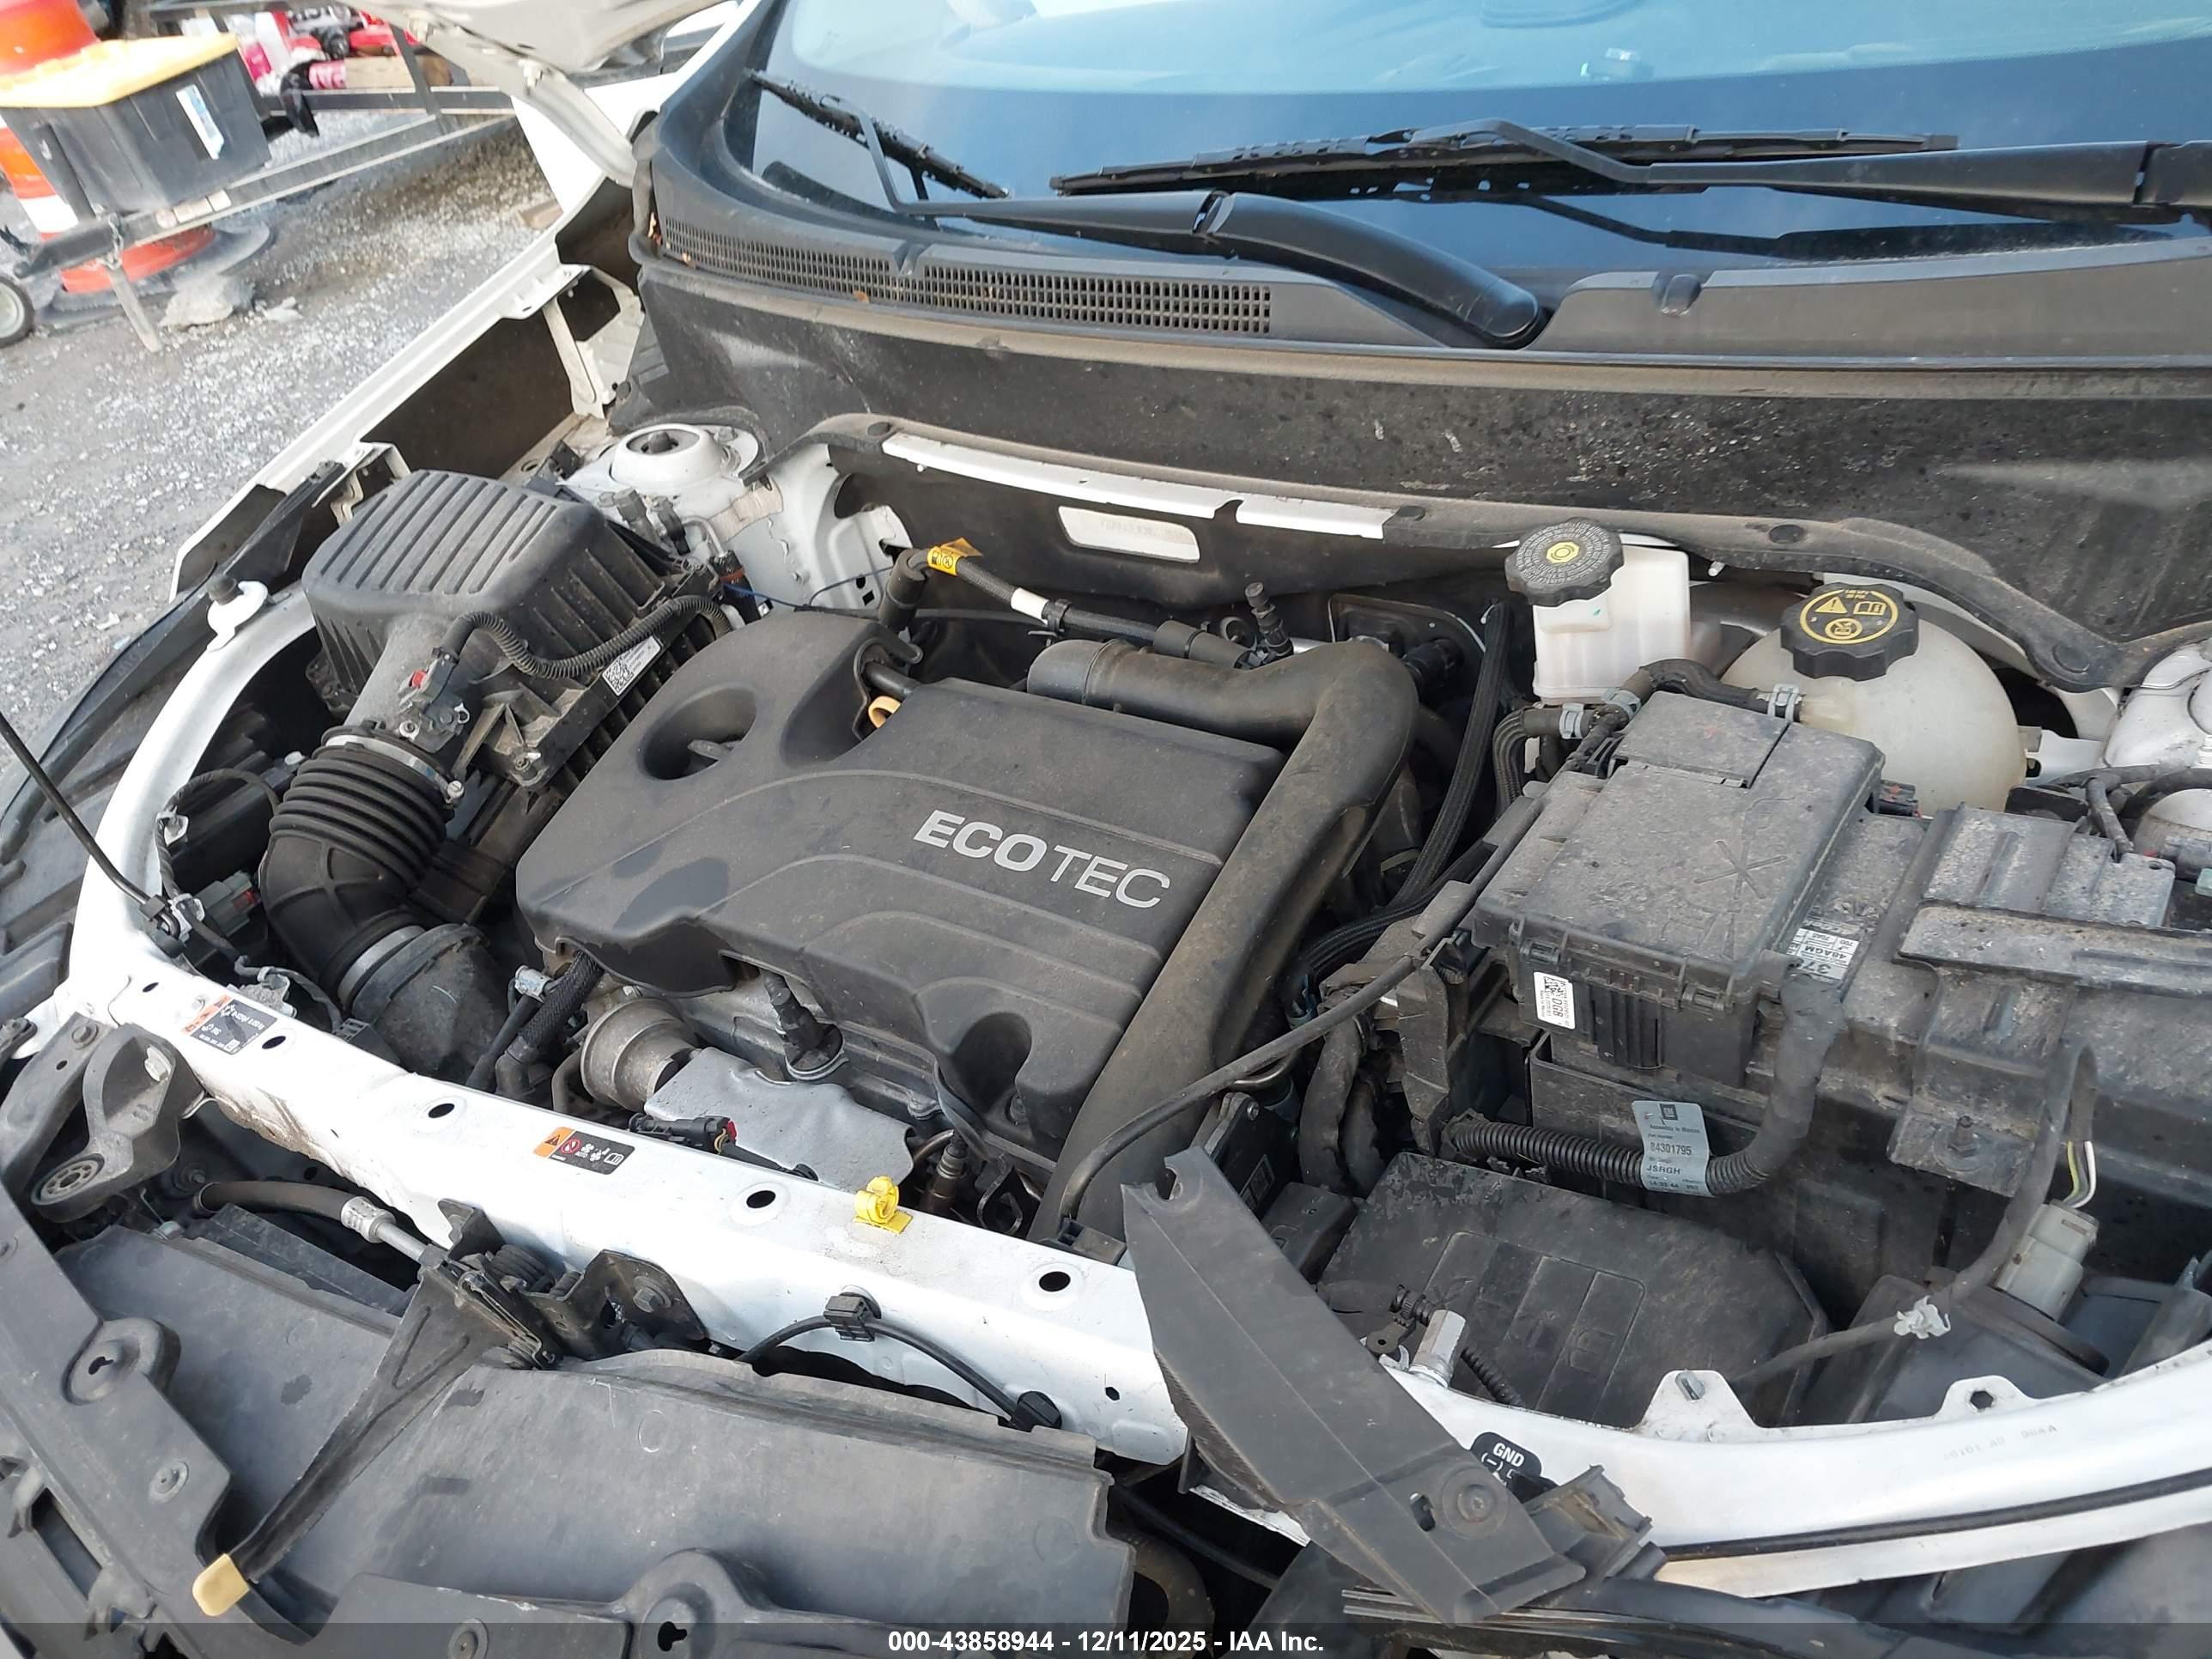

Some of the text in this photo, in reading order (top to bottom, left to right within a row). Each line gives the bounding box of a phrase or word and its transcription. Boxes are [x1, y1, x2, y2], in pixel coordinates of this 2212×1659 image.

[913, 809, 1170, 908] ECOTEC
[1804, 945, 1847, 959] 48AGM
[1492, 1443, 1525, 1468] GND
